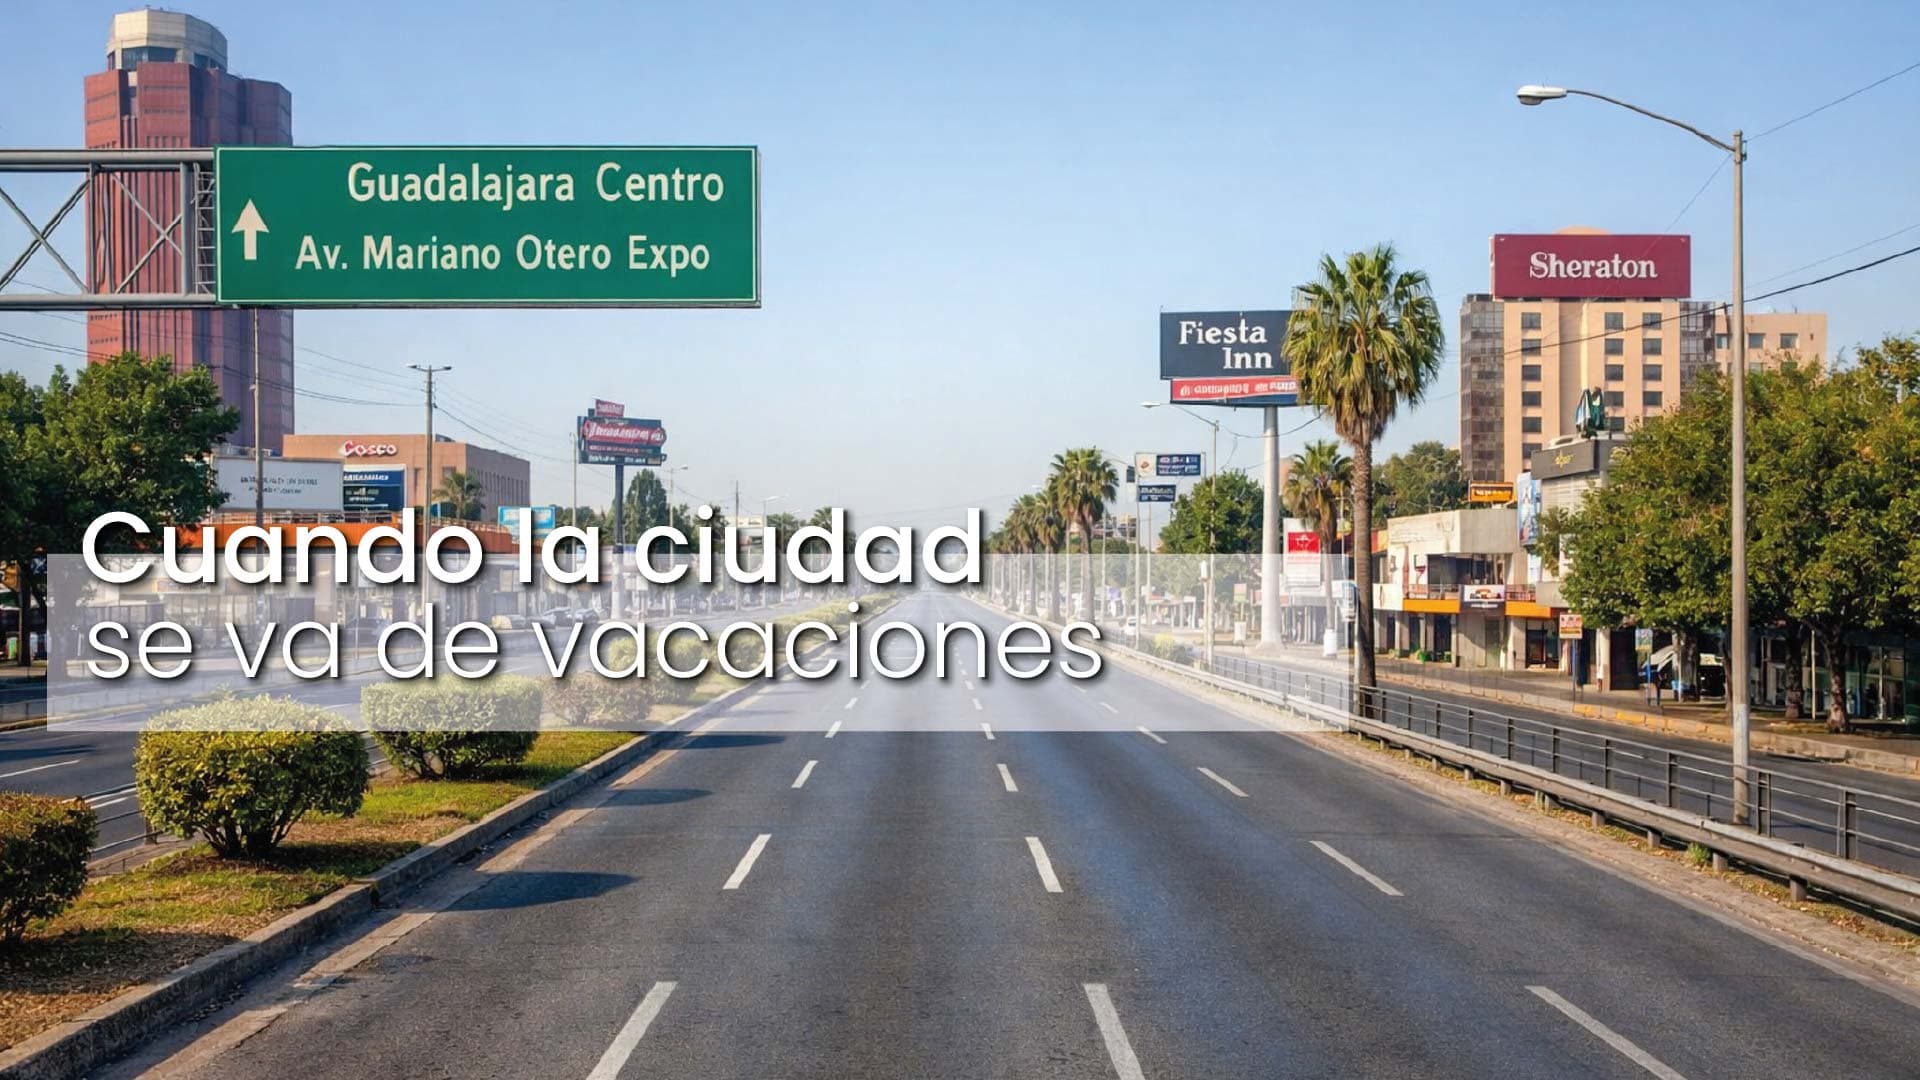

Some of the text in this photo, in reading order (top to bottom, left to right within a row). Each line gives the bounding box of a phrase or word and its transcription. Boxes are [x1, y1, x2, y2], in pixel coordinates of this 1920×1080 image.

[348, 162, 724, 211] Guadalajara Centro
[296, 234, 710, 277] Av. Mariano Otero Expo
[1529, 251, 1658, 279] Sheraton
[1178, 318, 1268, 345] Fiesta
[1221, 346, 1273, 369] Inn
